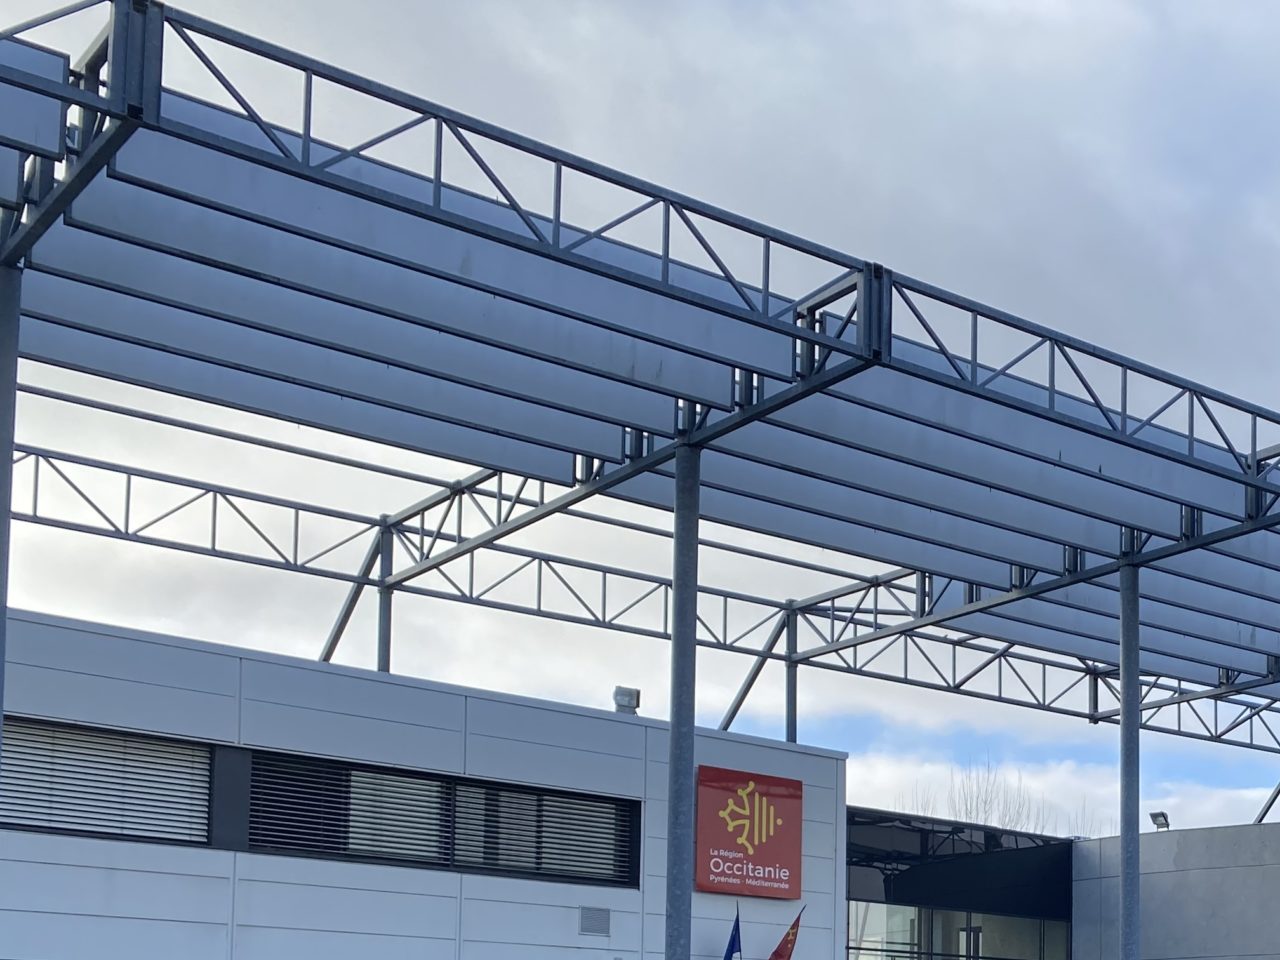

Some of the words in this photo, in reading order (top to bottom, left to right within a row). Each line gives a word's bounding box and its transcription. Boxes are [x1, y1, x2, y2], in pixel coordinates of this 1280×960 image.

[720, 849, 743, 858] Région
[710, 858, 790, 880] Occitanie
[709, 874, 740, 884] Pyrénées
[746, 878, 789, 889] Méditerranée
